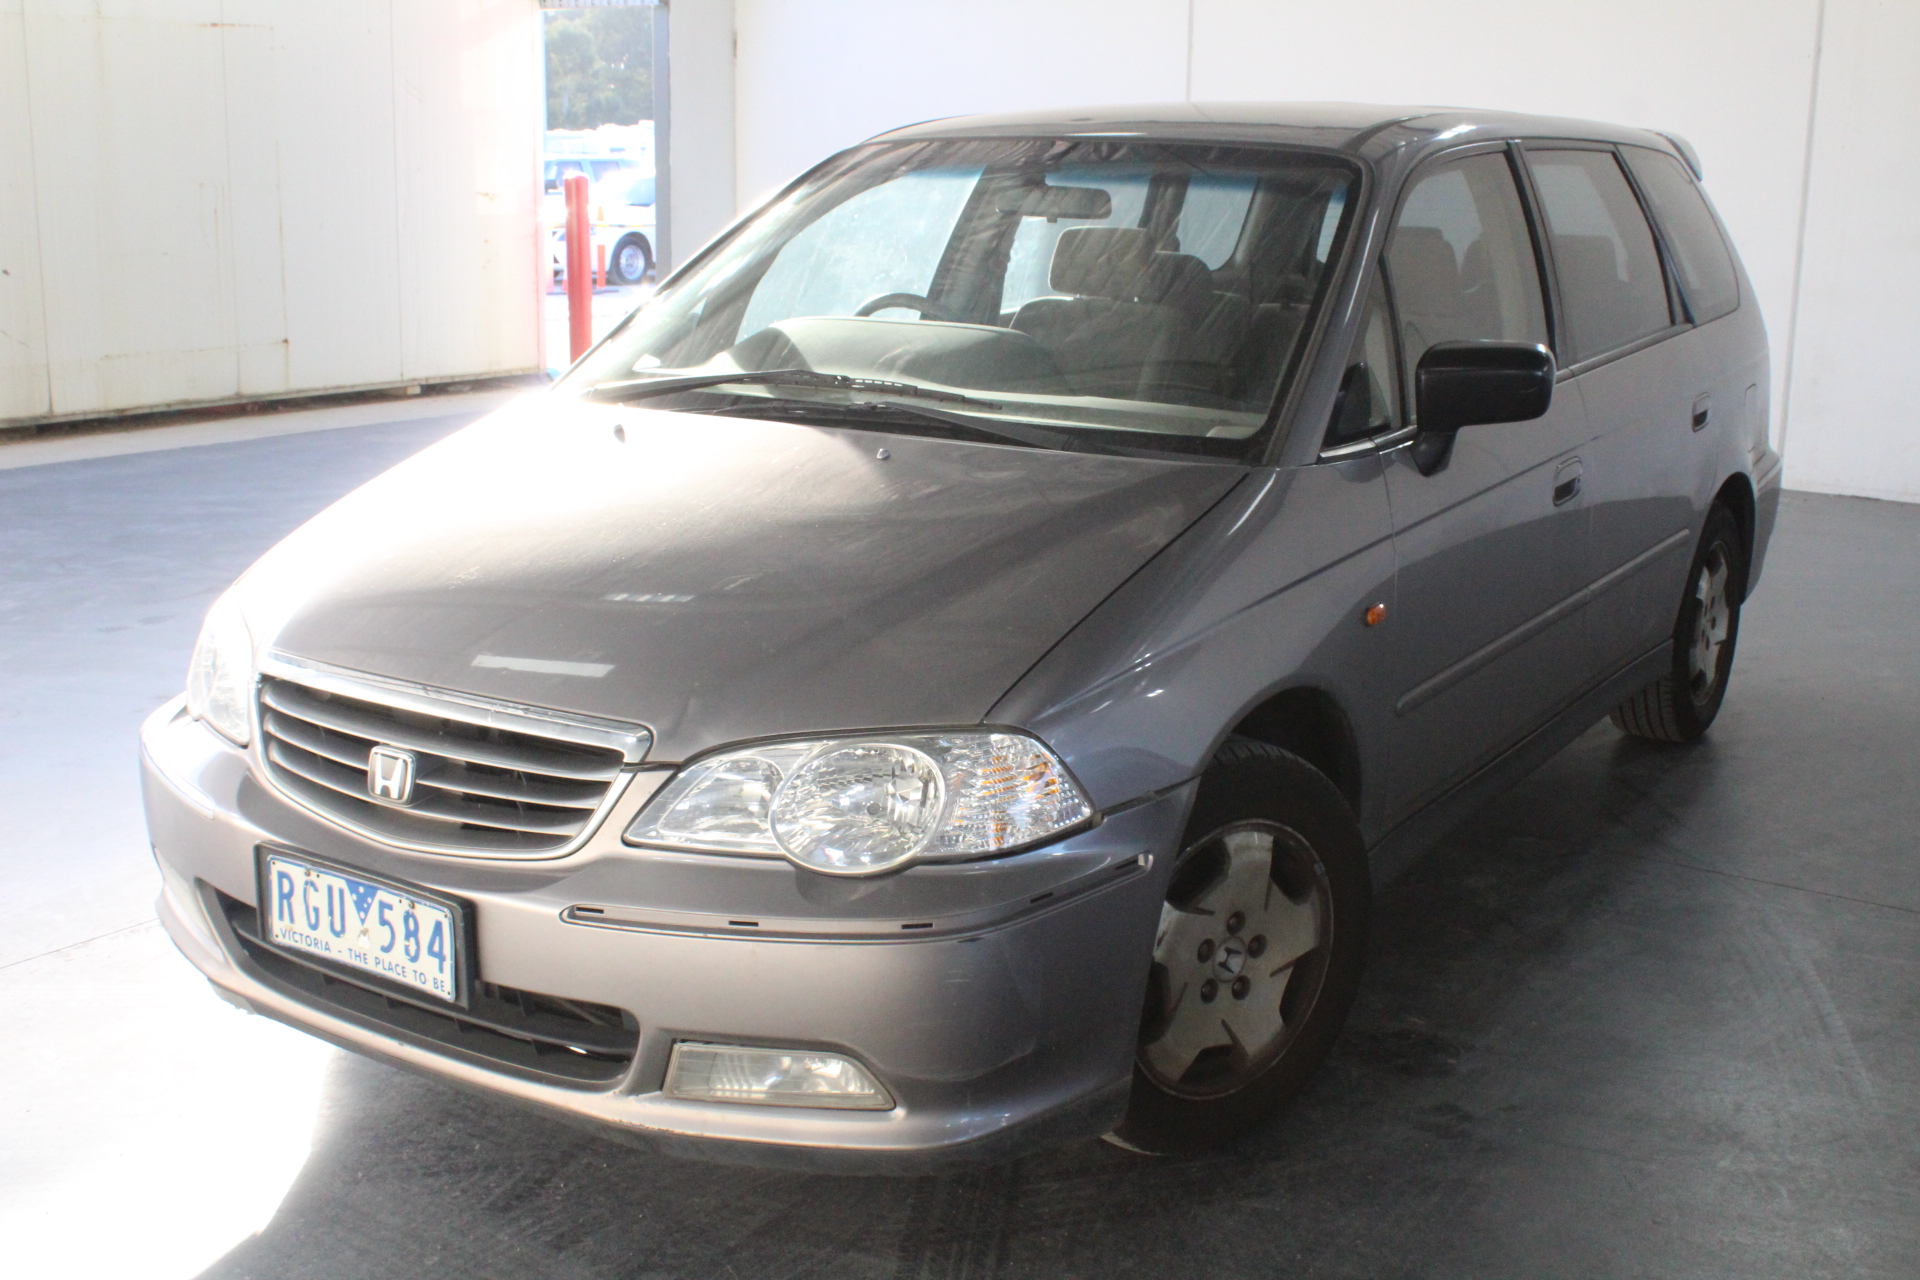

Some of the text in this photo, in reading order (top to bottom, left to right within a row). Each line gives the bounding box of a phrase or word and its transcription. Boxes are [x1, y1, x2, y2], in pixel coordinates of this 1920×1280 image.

[276, 870, 446, 974] RGU 584
[280, 927, 331, 953] VICTORIA
[347, 948, 368, 965] THE
[374, 956, 407, 978] PLACE
[412, 969, 427, 985] TO
[433, 977, 446, 992] BE
